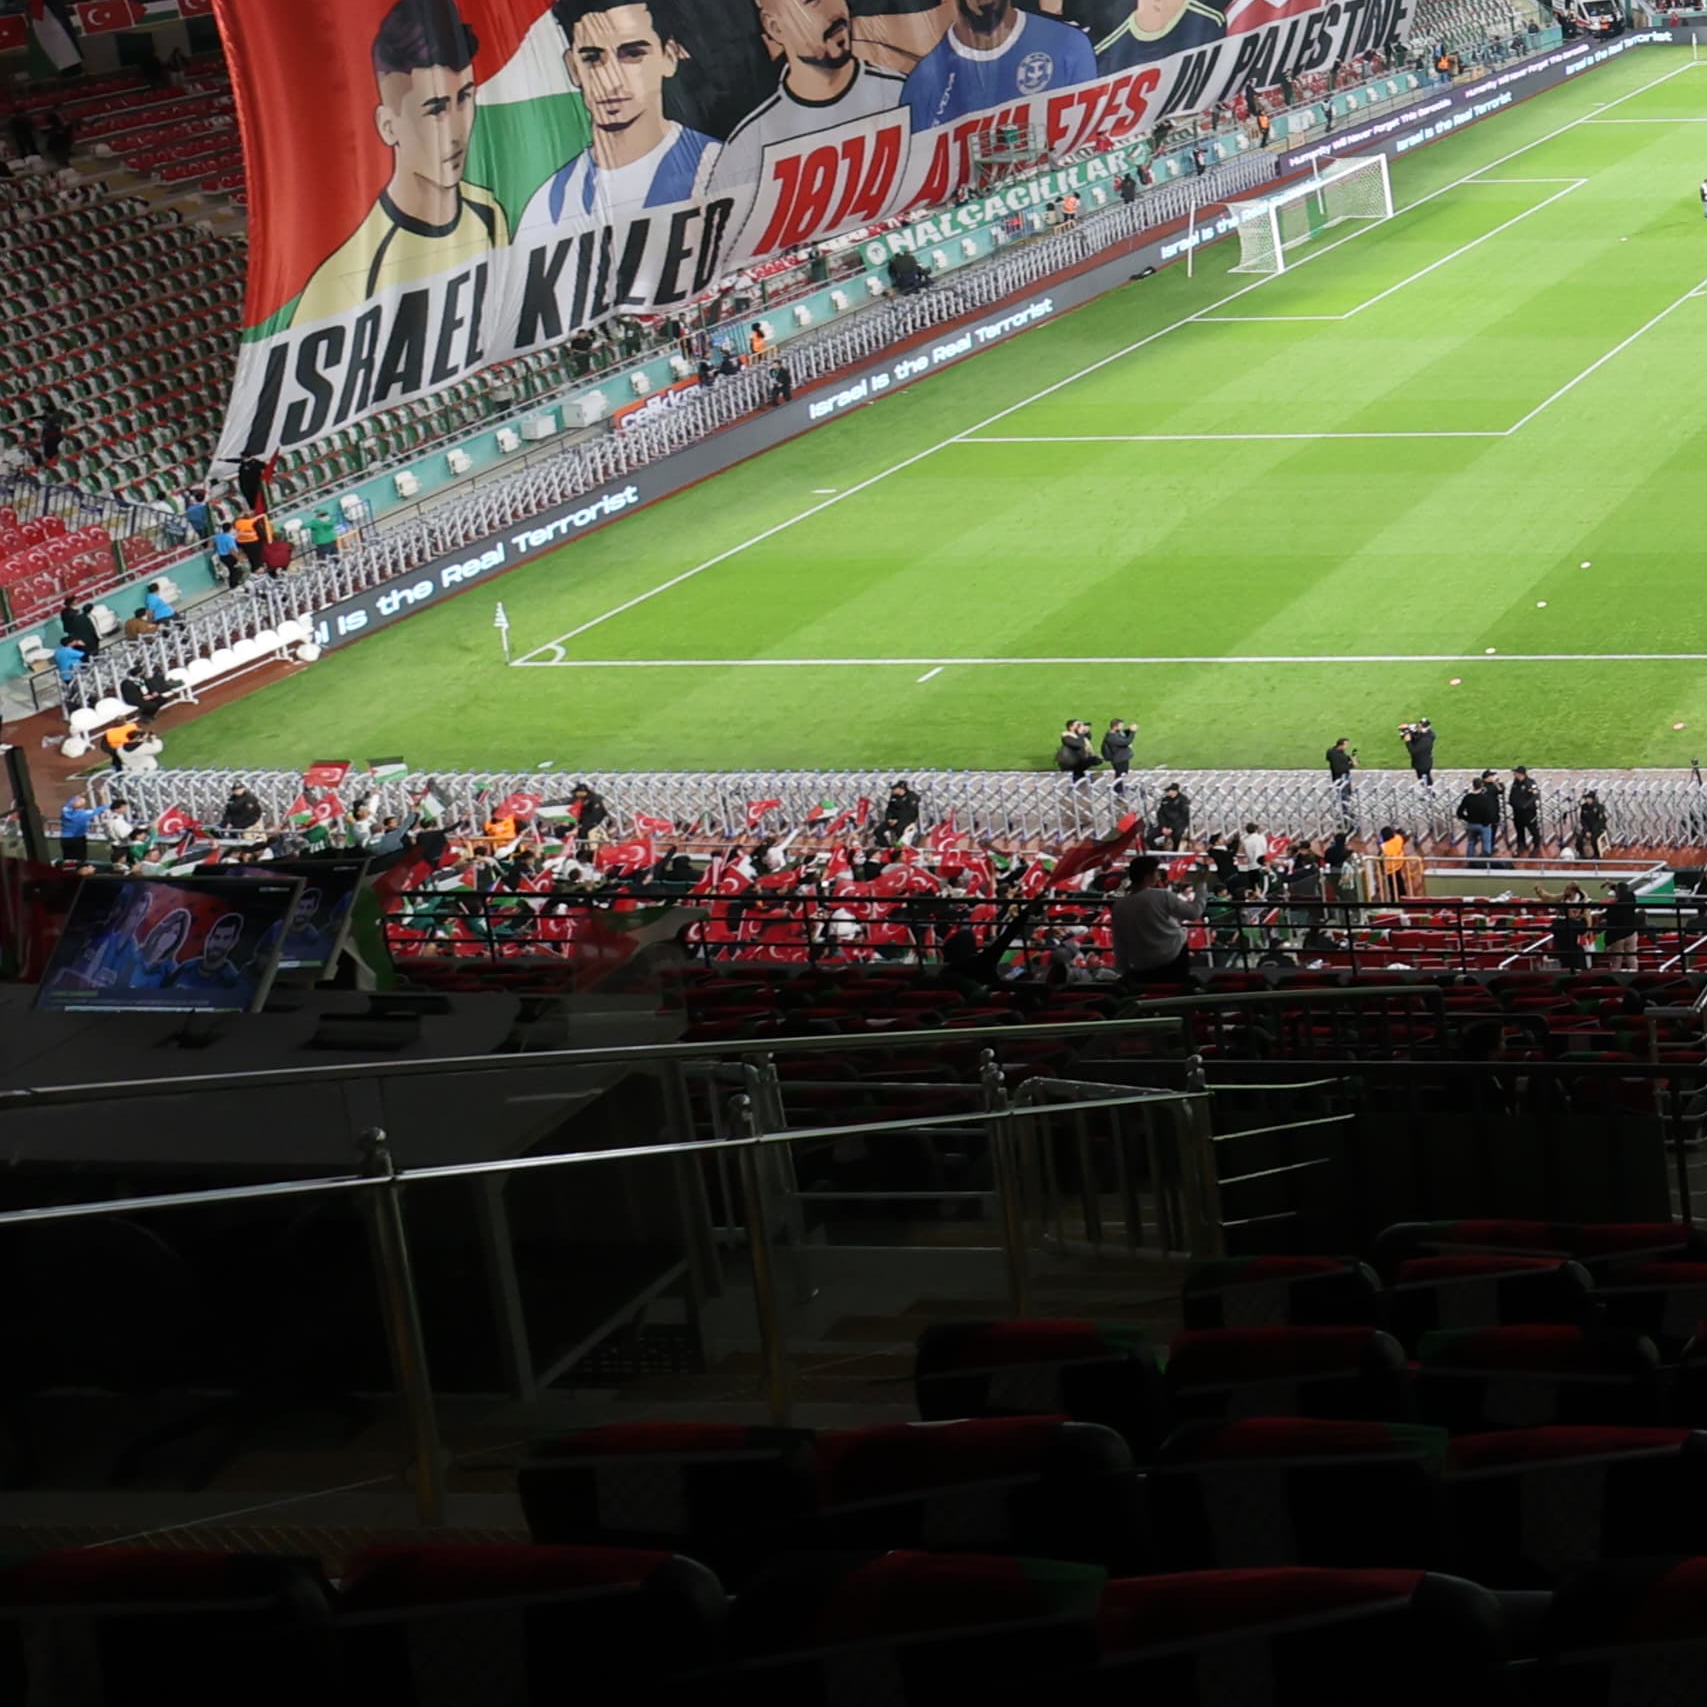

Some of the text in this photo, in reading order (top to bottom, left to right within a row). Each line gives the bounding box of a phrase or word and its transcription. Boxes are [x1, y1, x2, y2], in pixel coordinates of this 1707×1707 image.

[751, 125, 901, 256] 1814
[1158, 44, 1224, 118] IN
[1435, 117, 1452, 134] the
[247, 197, 733, 456] ISRAEL KILLED
[809, 379, 867, 419] Israel
[894, 355, 929, 380] the
[932, 333, 971, 364] Real
[975, 297, 1053, 343] Terrorist
[376, 580, 433, 616] the
[441, 541, 504, 588] Real
[511, 484, 639, 553] Terrorist
